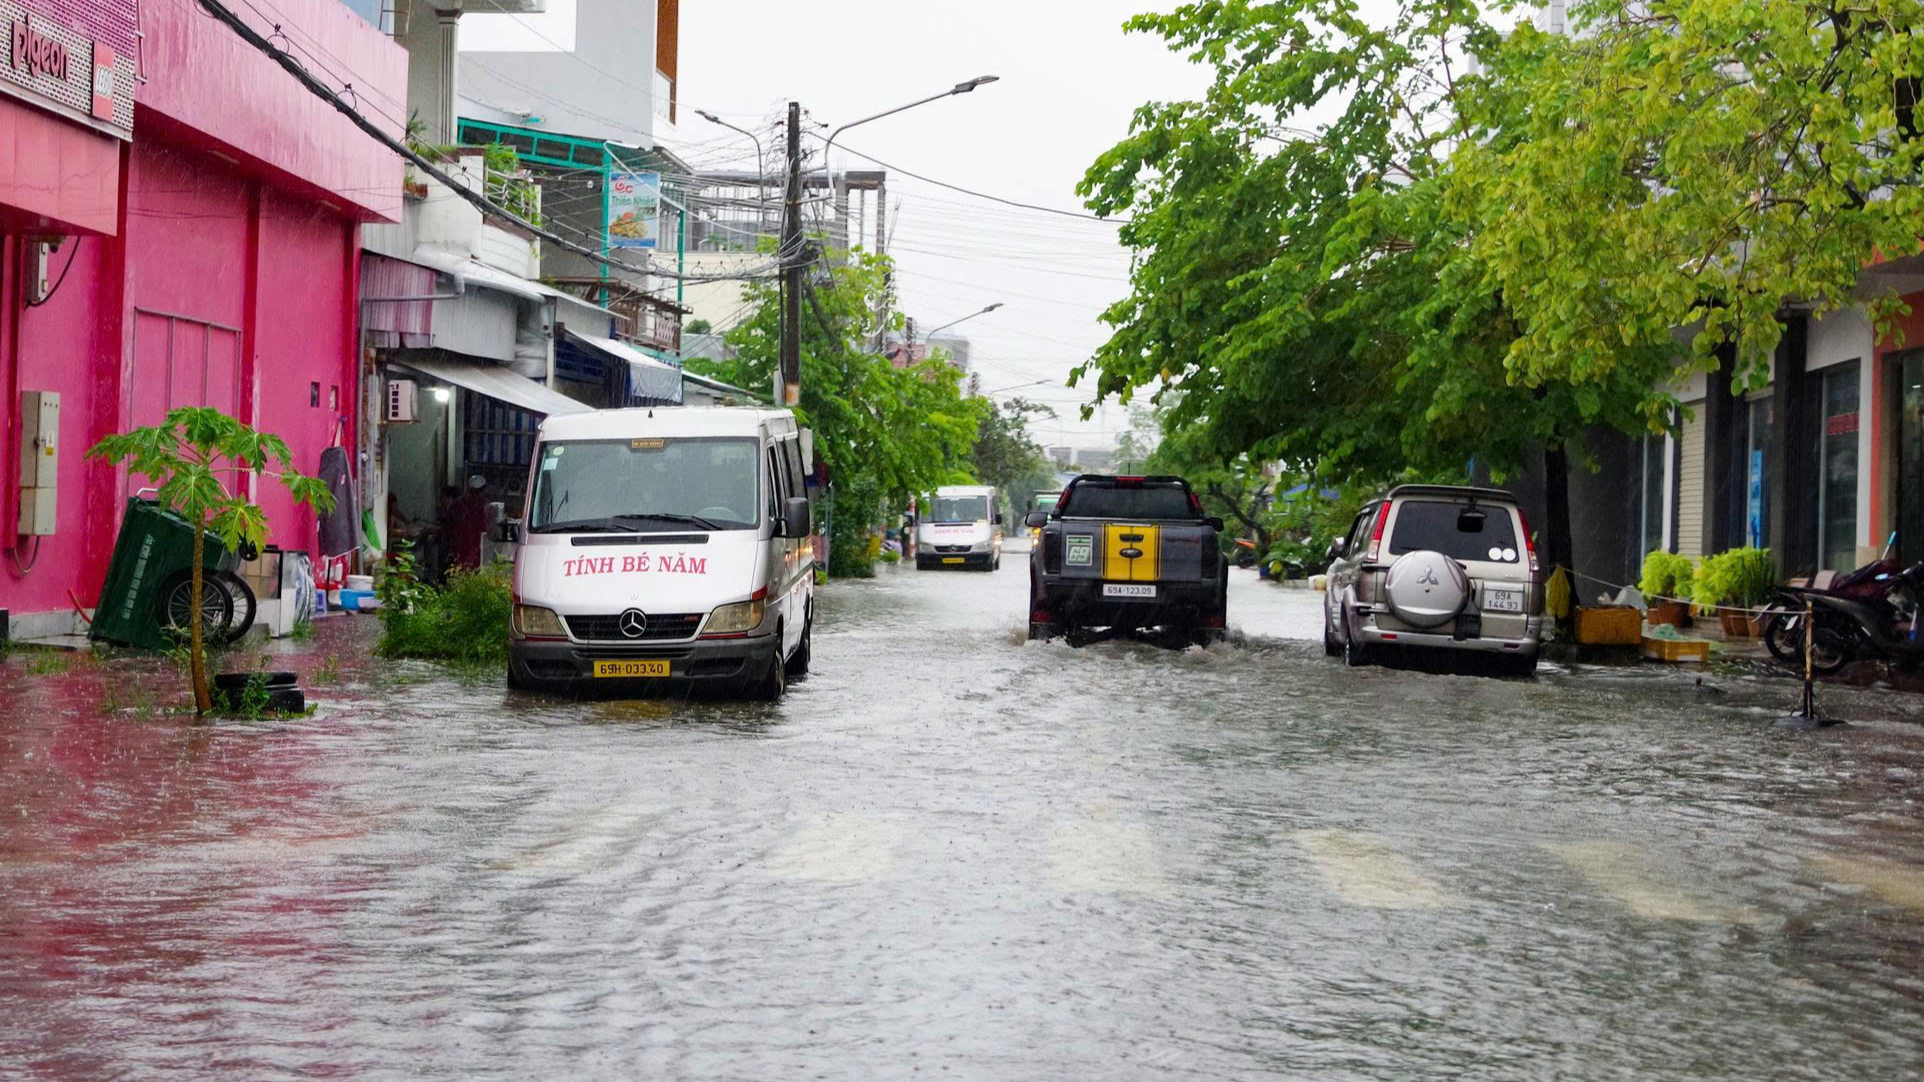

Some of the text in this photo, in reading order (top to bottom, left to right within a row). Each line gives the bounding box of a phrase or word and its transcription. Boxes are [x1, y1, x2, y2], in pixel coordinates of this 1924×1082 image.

[11, 13, 70, 82] pigeon
[563, 551, 708, 577] TÍNH BÉ NĂM
[1494, 591, 1511, 600] 69A
